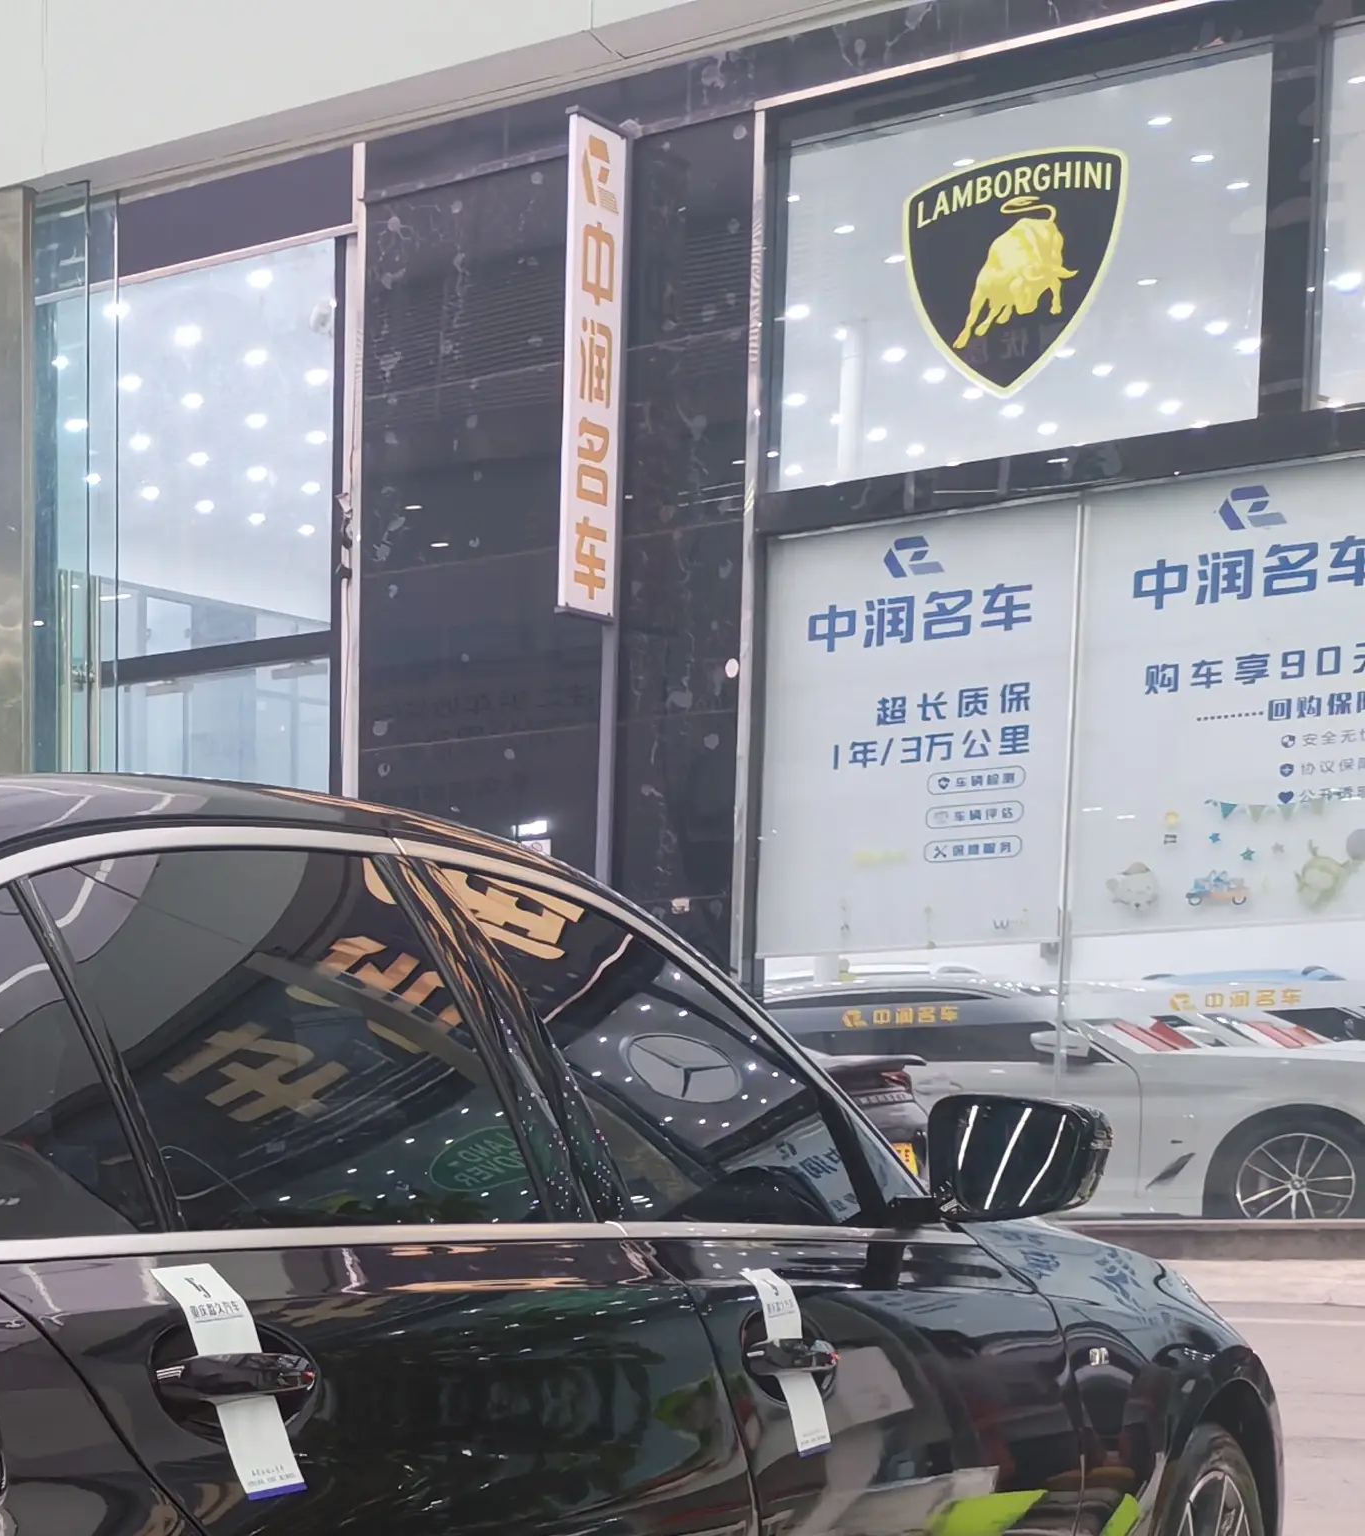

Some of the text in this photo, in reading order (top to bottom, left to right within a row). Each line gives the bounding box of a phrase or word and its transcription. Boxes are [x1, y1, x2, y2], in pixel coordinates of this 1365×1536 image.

[916, 160, 1114, 228] LAMBORGHINI
[574, 221, 615, 600] 中润名车
[808, 583, 1033, 652] 中润名车
[876, 682, 1031, 727] 超长质保
[832, 724, 1030, 769] 1年/3万公里
